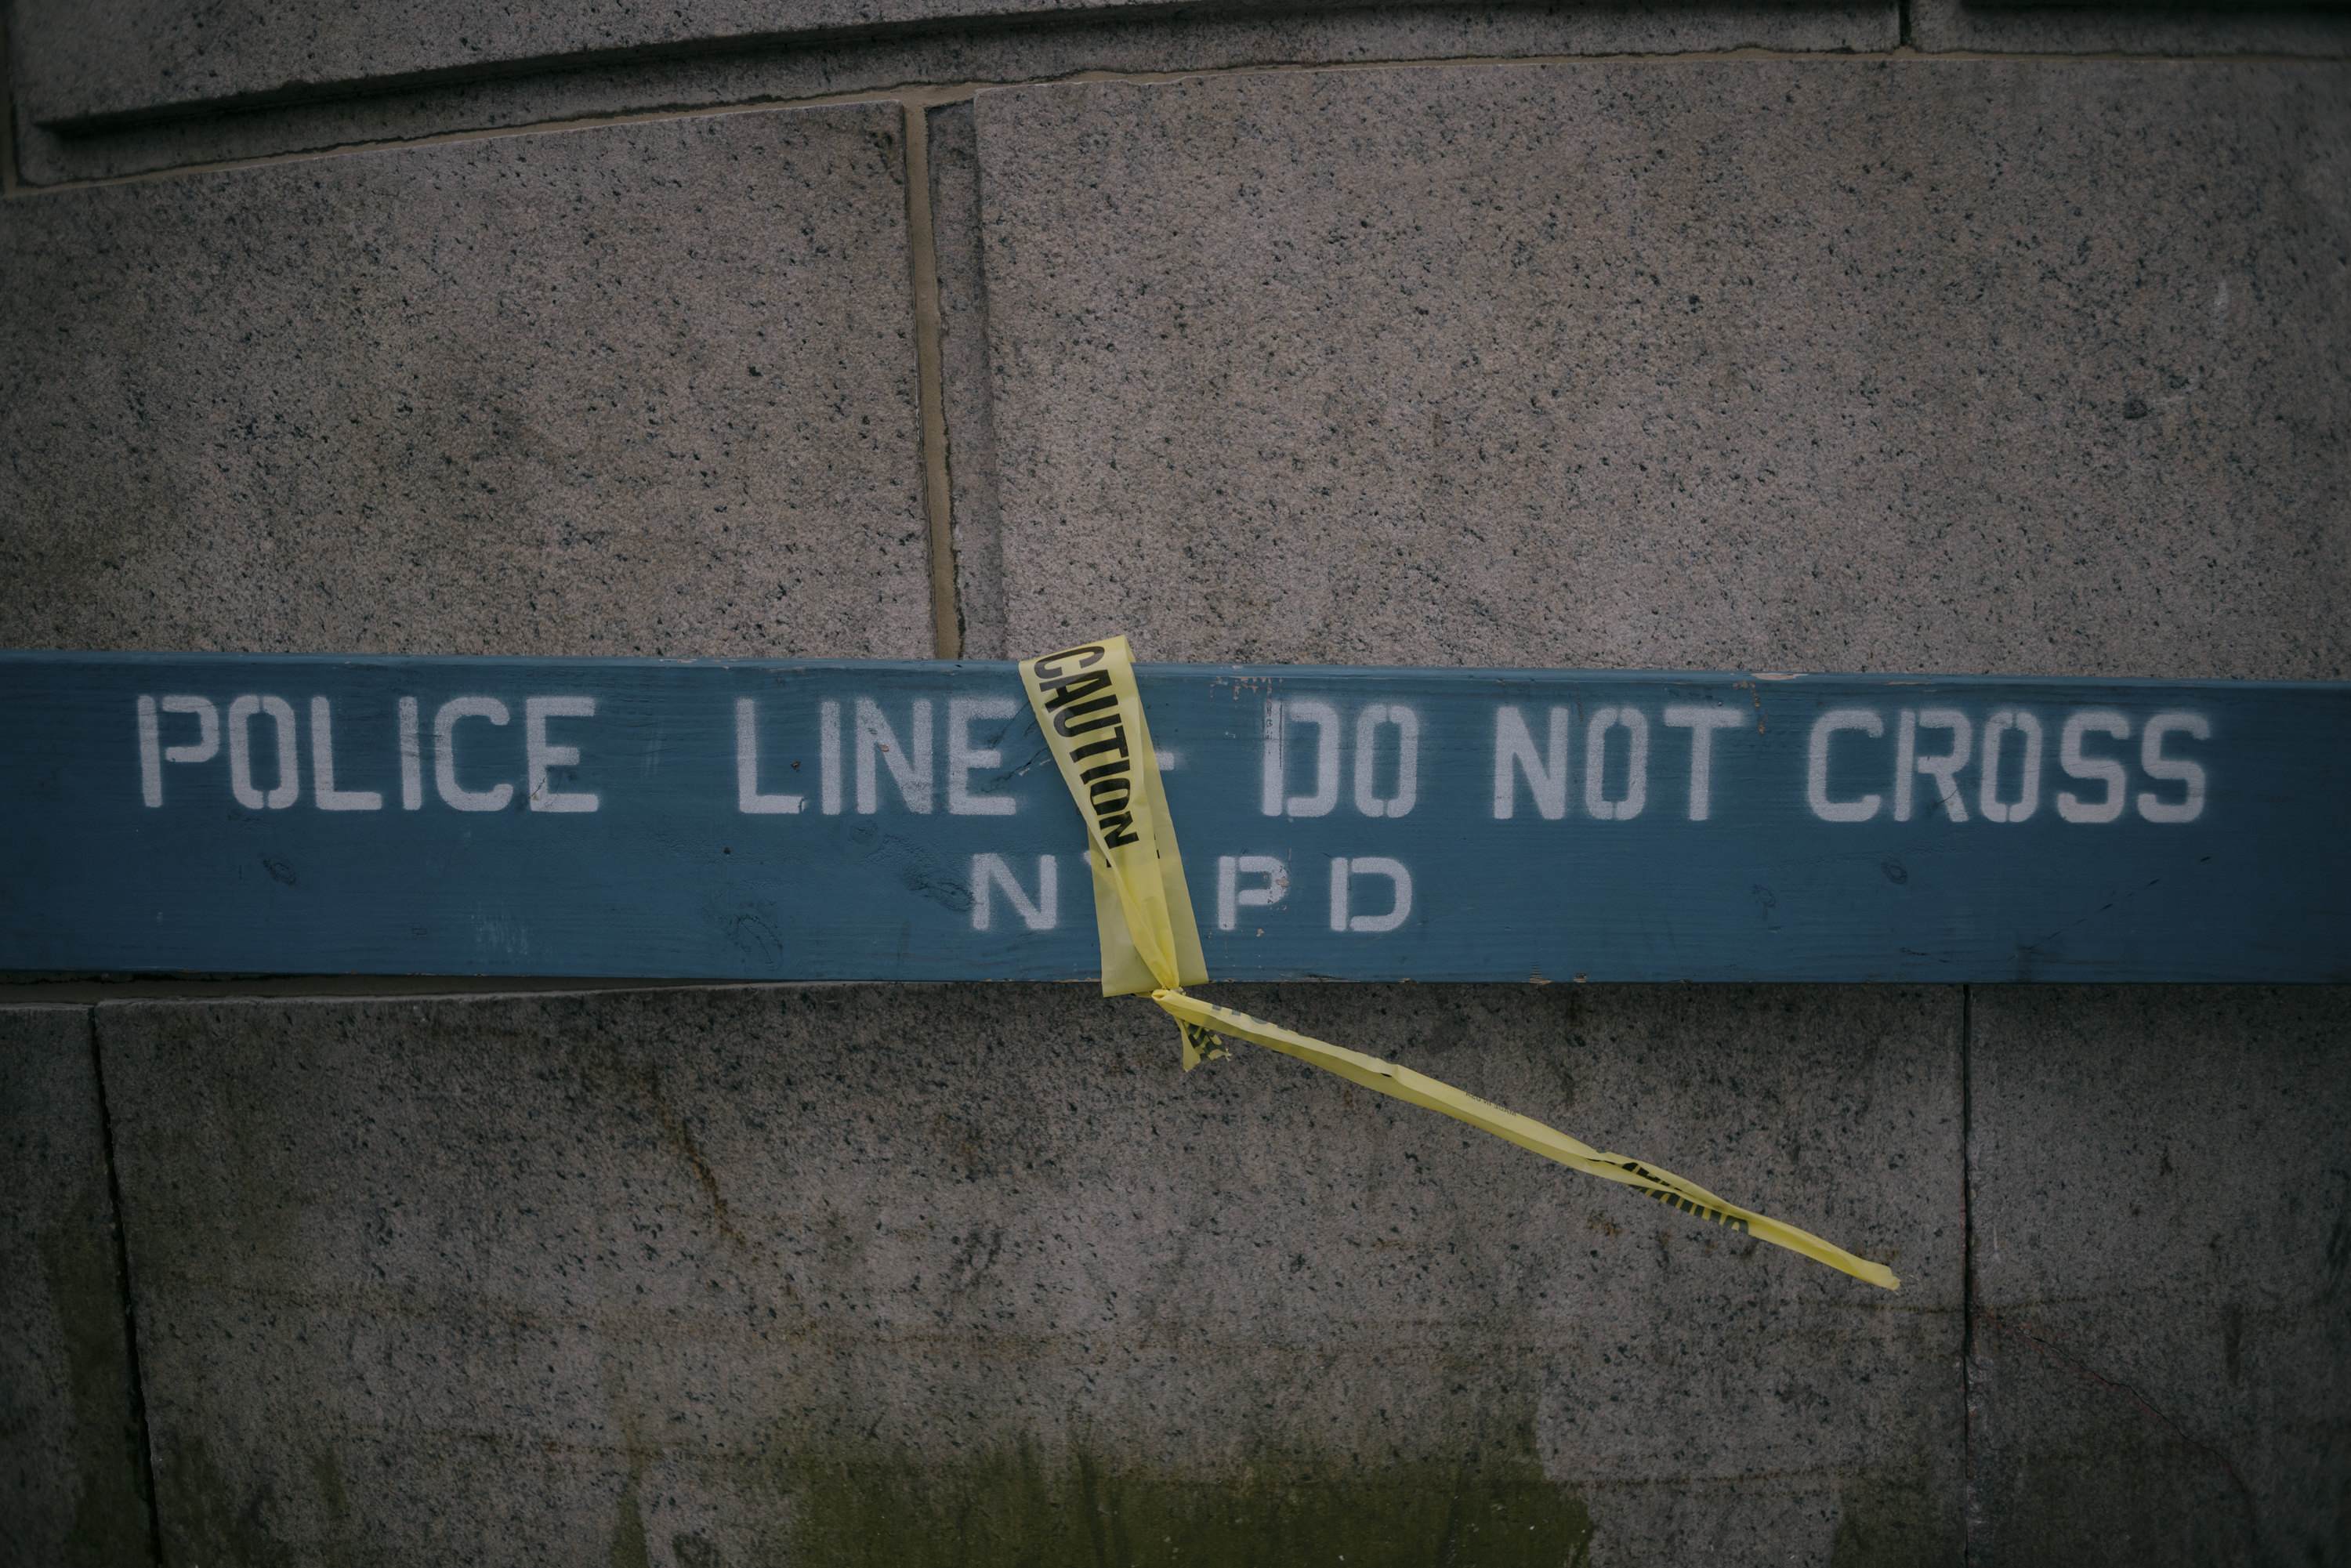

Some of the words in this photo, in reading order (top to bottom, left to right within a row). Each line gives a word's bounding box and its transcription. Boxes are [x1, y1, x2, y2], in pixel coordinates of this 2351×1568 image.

[136, 693, 600, 813] POLICE
[735, 697, 1017, 816] LINE
[1261, 701, 1418, 818] DO
[1493, 705, 1746, 821] NOT
[1806, 707, 2212, 824] CROSS
[1034, 645, 1140, 849] CAUTION
[972, 852, 1412, 932] NPD
